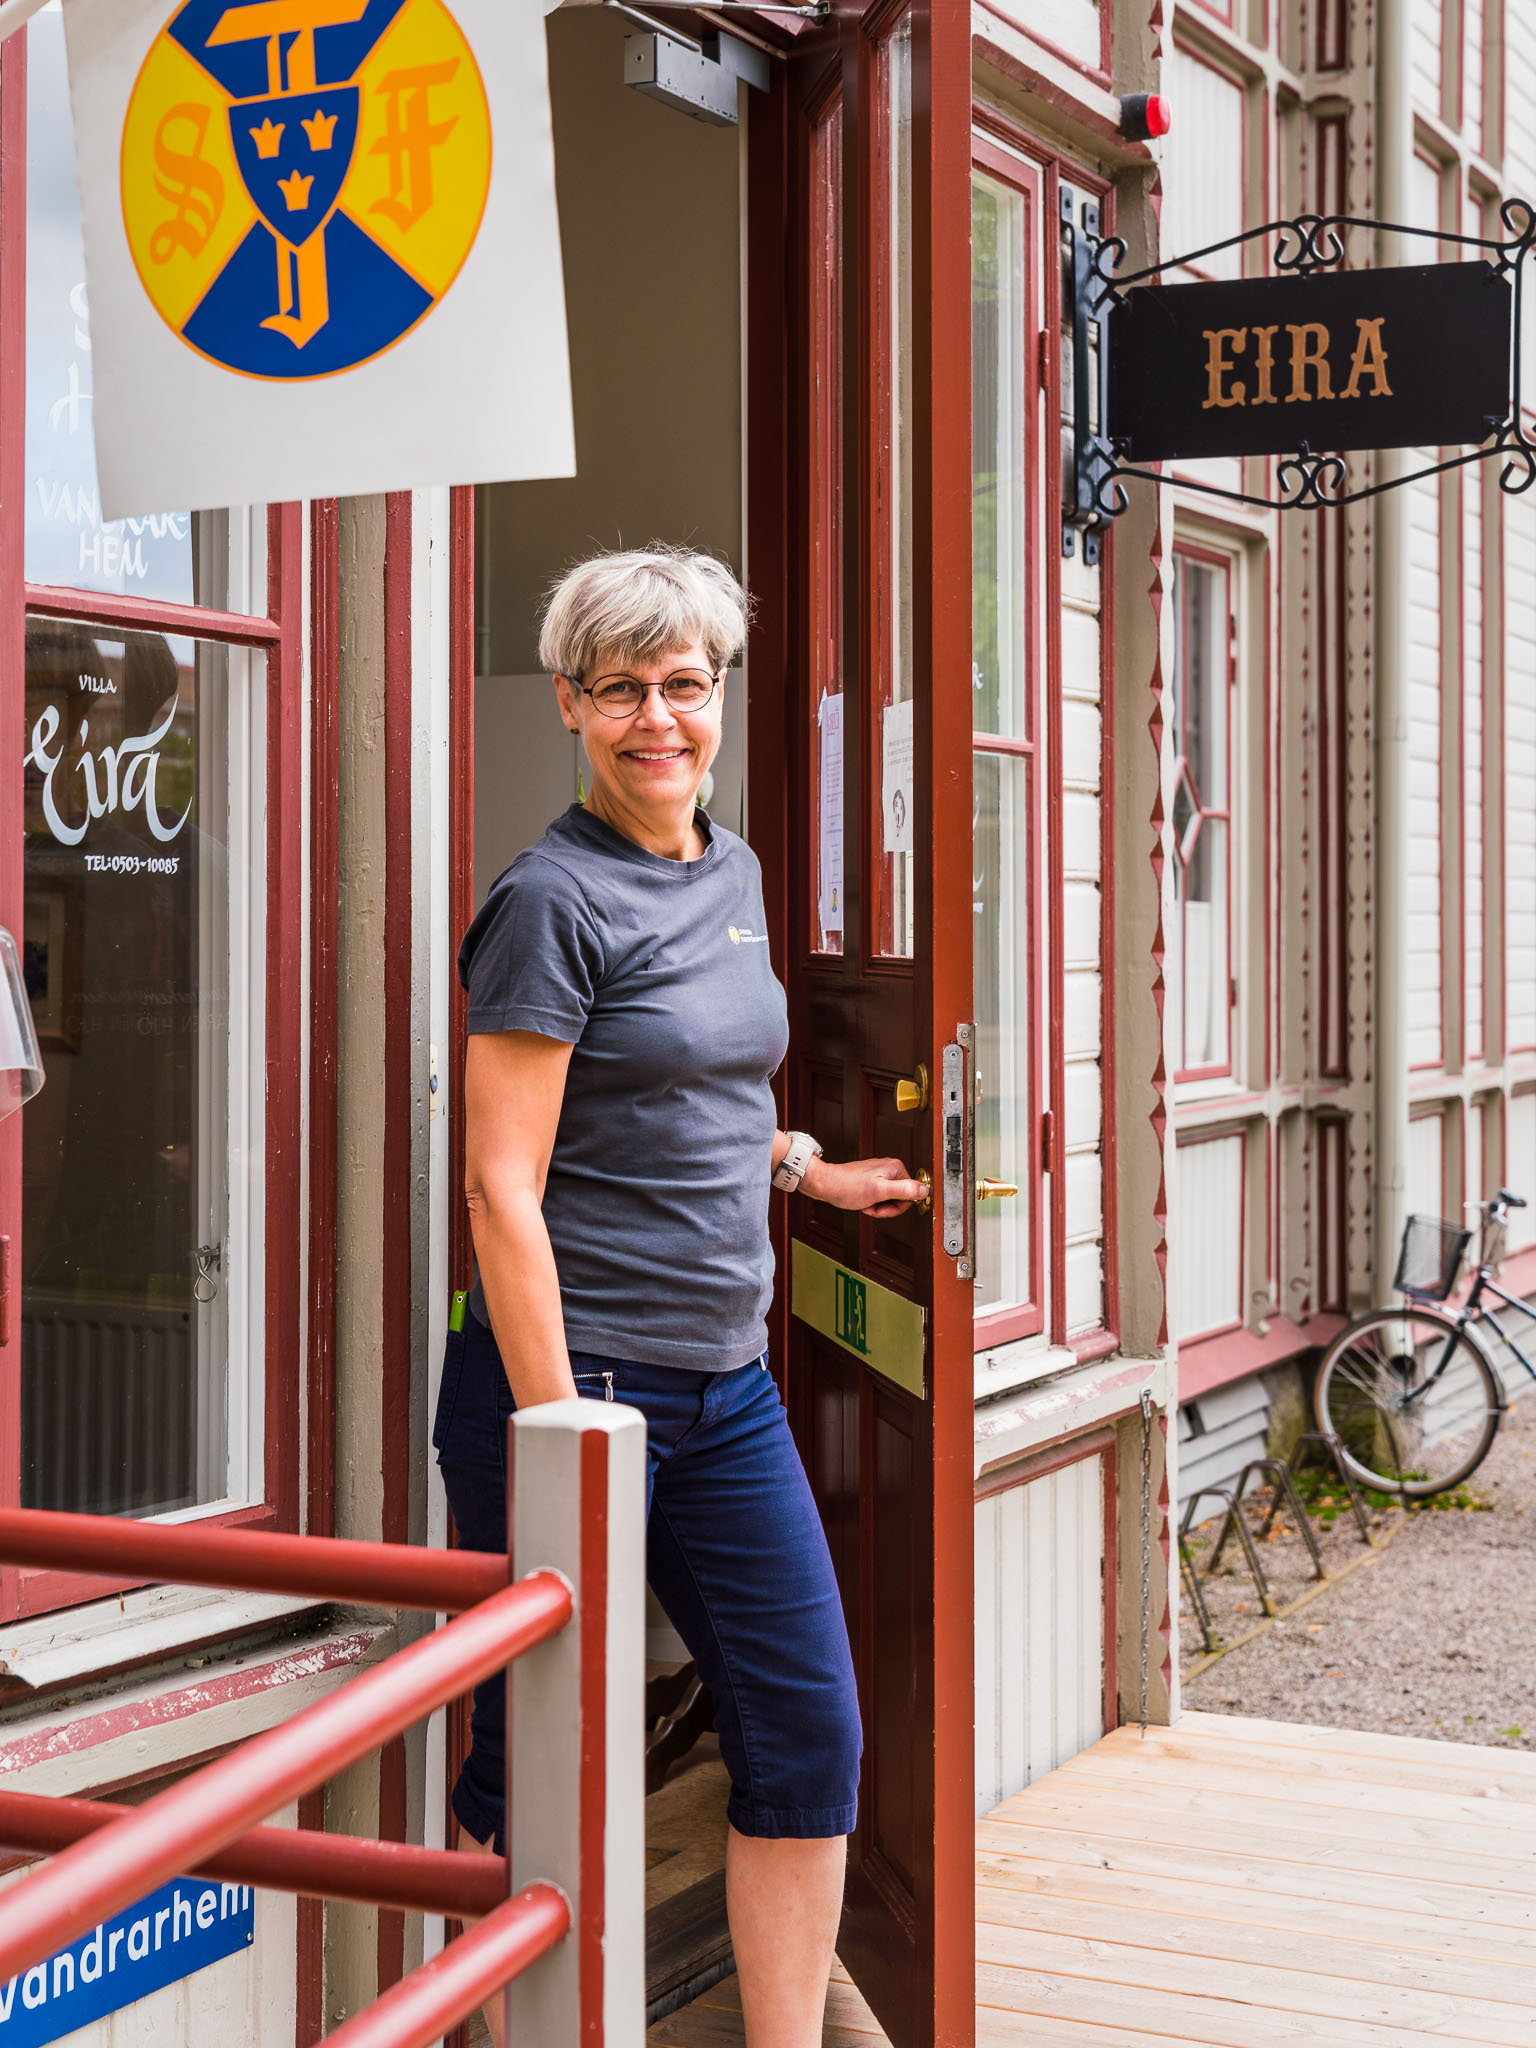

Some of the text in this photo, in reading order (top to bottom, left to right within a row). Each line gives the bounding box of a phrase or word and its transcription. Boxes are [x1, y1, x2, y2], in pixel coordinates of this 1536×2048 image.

[1202, 317, 1393, 409] EIRA
[79, 530, 149, 579] HEM
[79, 674, 117, 694] VILLA
[23, 693, 193, 846] Eira
